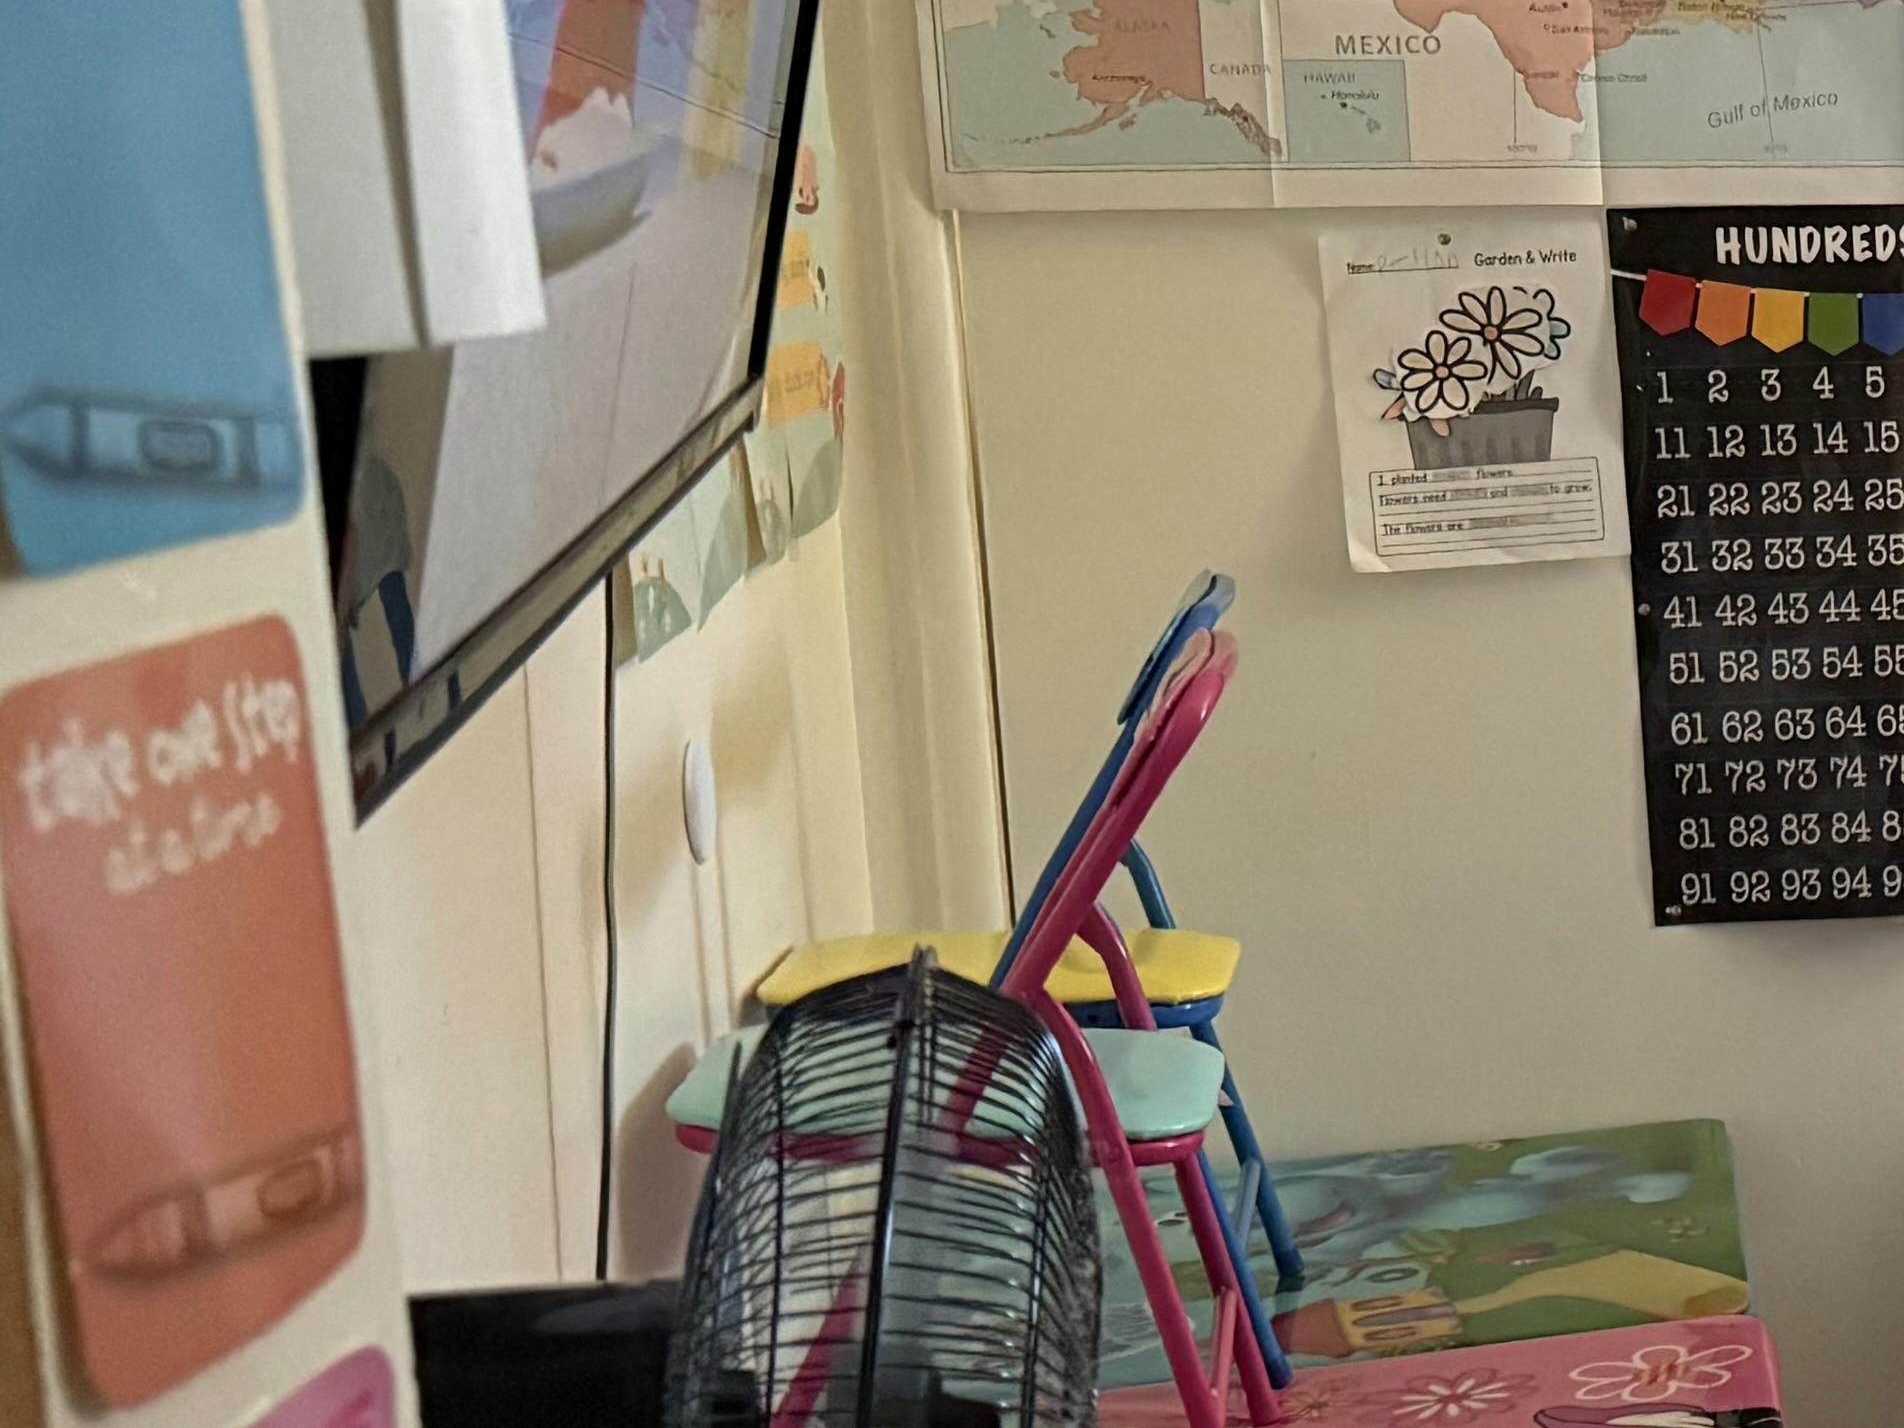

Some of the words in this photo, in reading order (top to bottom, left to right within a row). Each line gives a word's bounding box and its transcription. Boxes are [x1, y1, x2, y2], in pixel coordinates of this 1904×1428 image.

[1335, 35, 1441, 55] MEXICO
[1475, 252, 1522, 267] Garden
[1539, 250, 1577, 263] Write
[1865, 366, 1885, 398] 5
